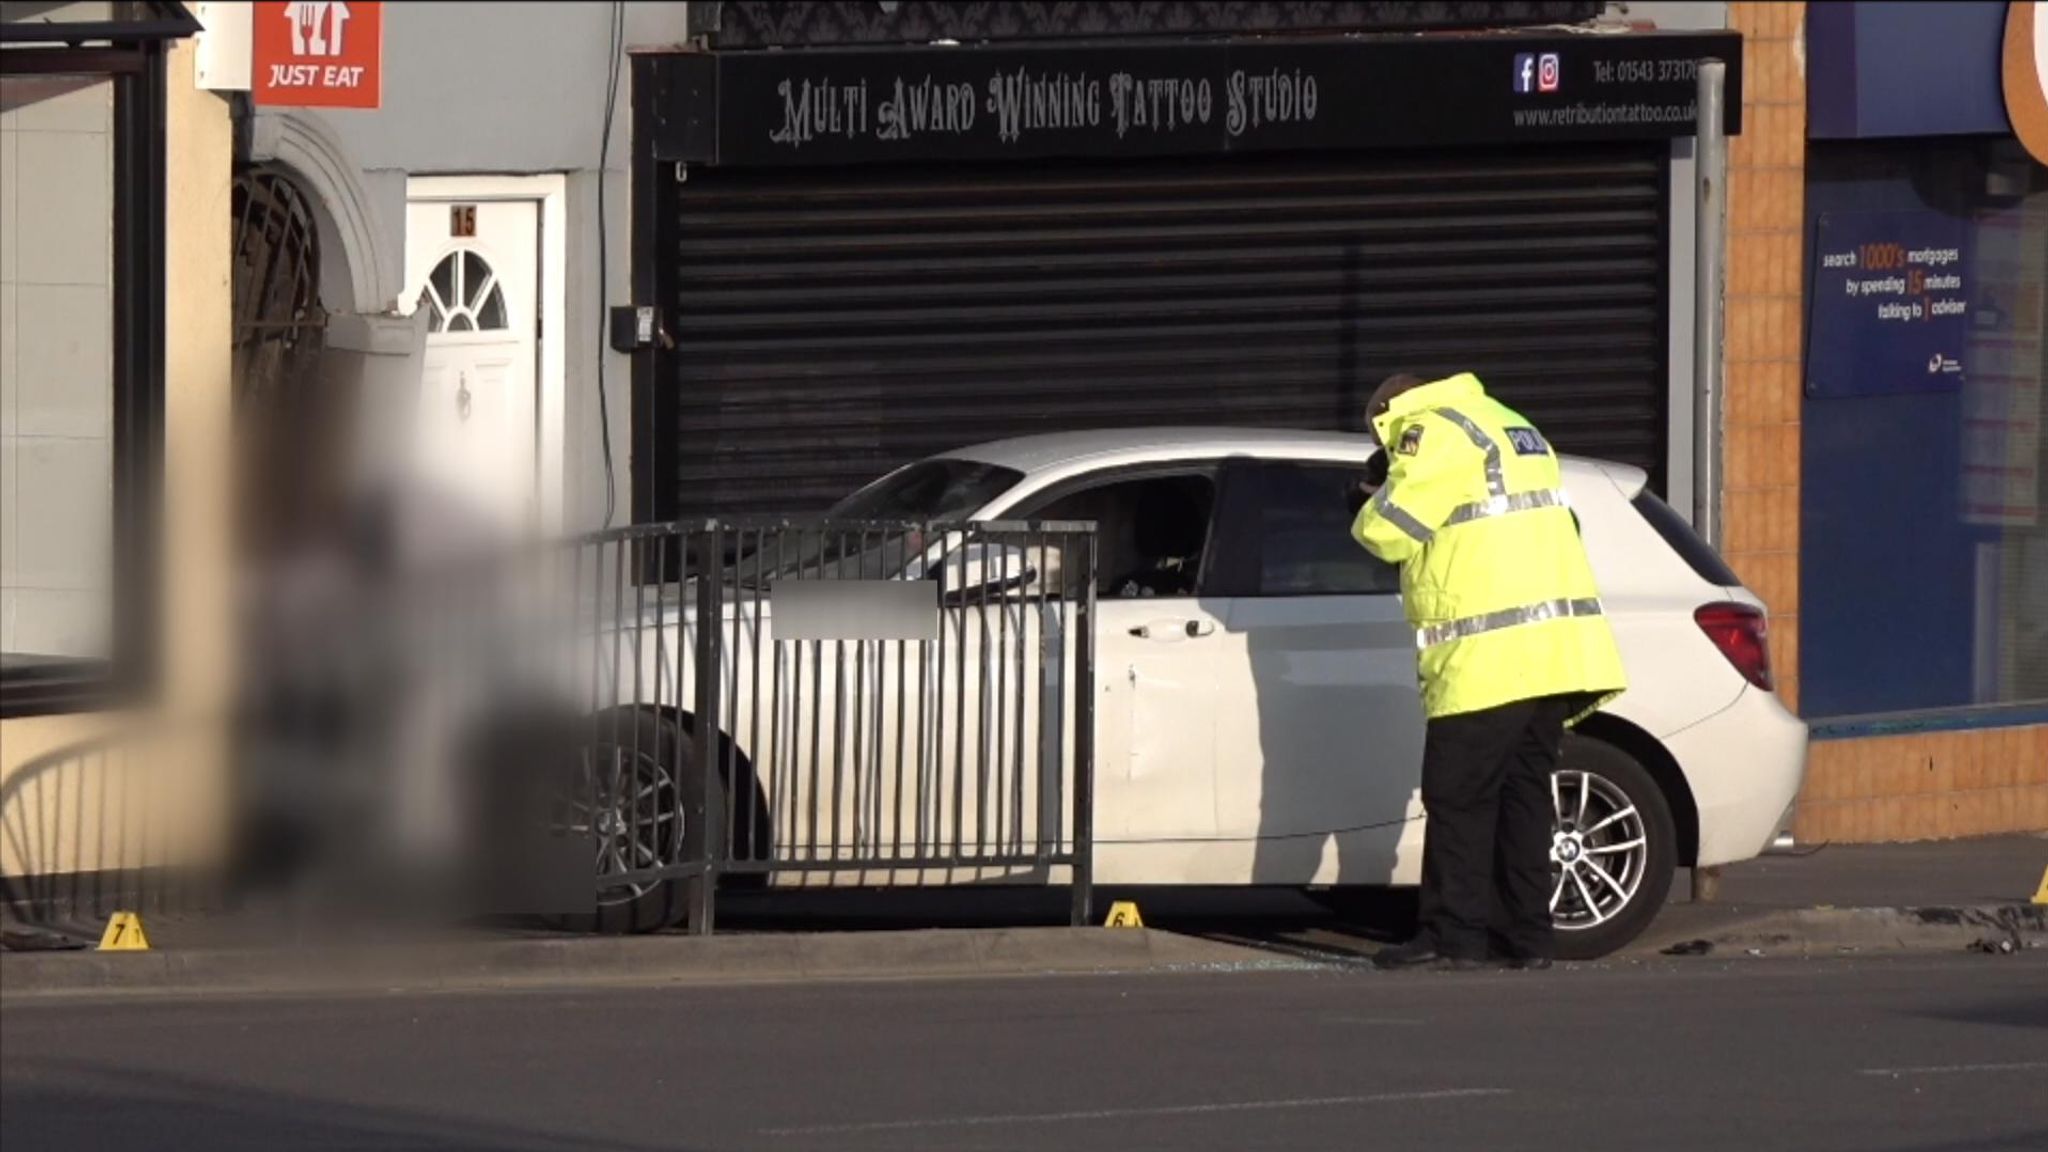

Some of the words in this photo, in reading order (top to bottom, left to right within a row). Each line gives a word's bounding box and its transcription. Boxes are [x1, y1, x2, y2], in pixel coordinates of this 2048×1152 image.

[268, 65, 319, 88] JUST
[323, 67, 363, 87] EAT
[1593, 61, 1615, 82] Tel:
[1617, 61, 1654, 81] 01543
[769, 77, 867, 148] MULTI
[876, 73, 976, 139] AWARD
[987, 65, 1101, 144] WINNING
[1110, 70, 1212, 139] TATTOO
[1226, 66, 1318, 136] STUDIO
[453, 207, 476, 236] 15
[1823, 252, 1856, 267] search
[1859, 243, 1904, 270] 1000's
[1907, 247, 1959, 266] mortgages
[1846, 279, 1858, 296] by
[1861, 276, 1905, 295] spending
[1908, 269, 1923, 295] 15
[1924, 274, 1961, 290] minutes
[1878, 303, 1911, 321] talking
[1912, 302, 1922, 319] to
[113, 923, 125, 946] 7
